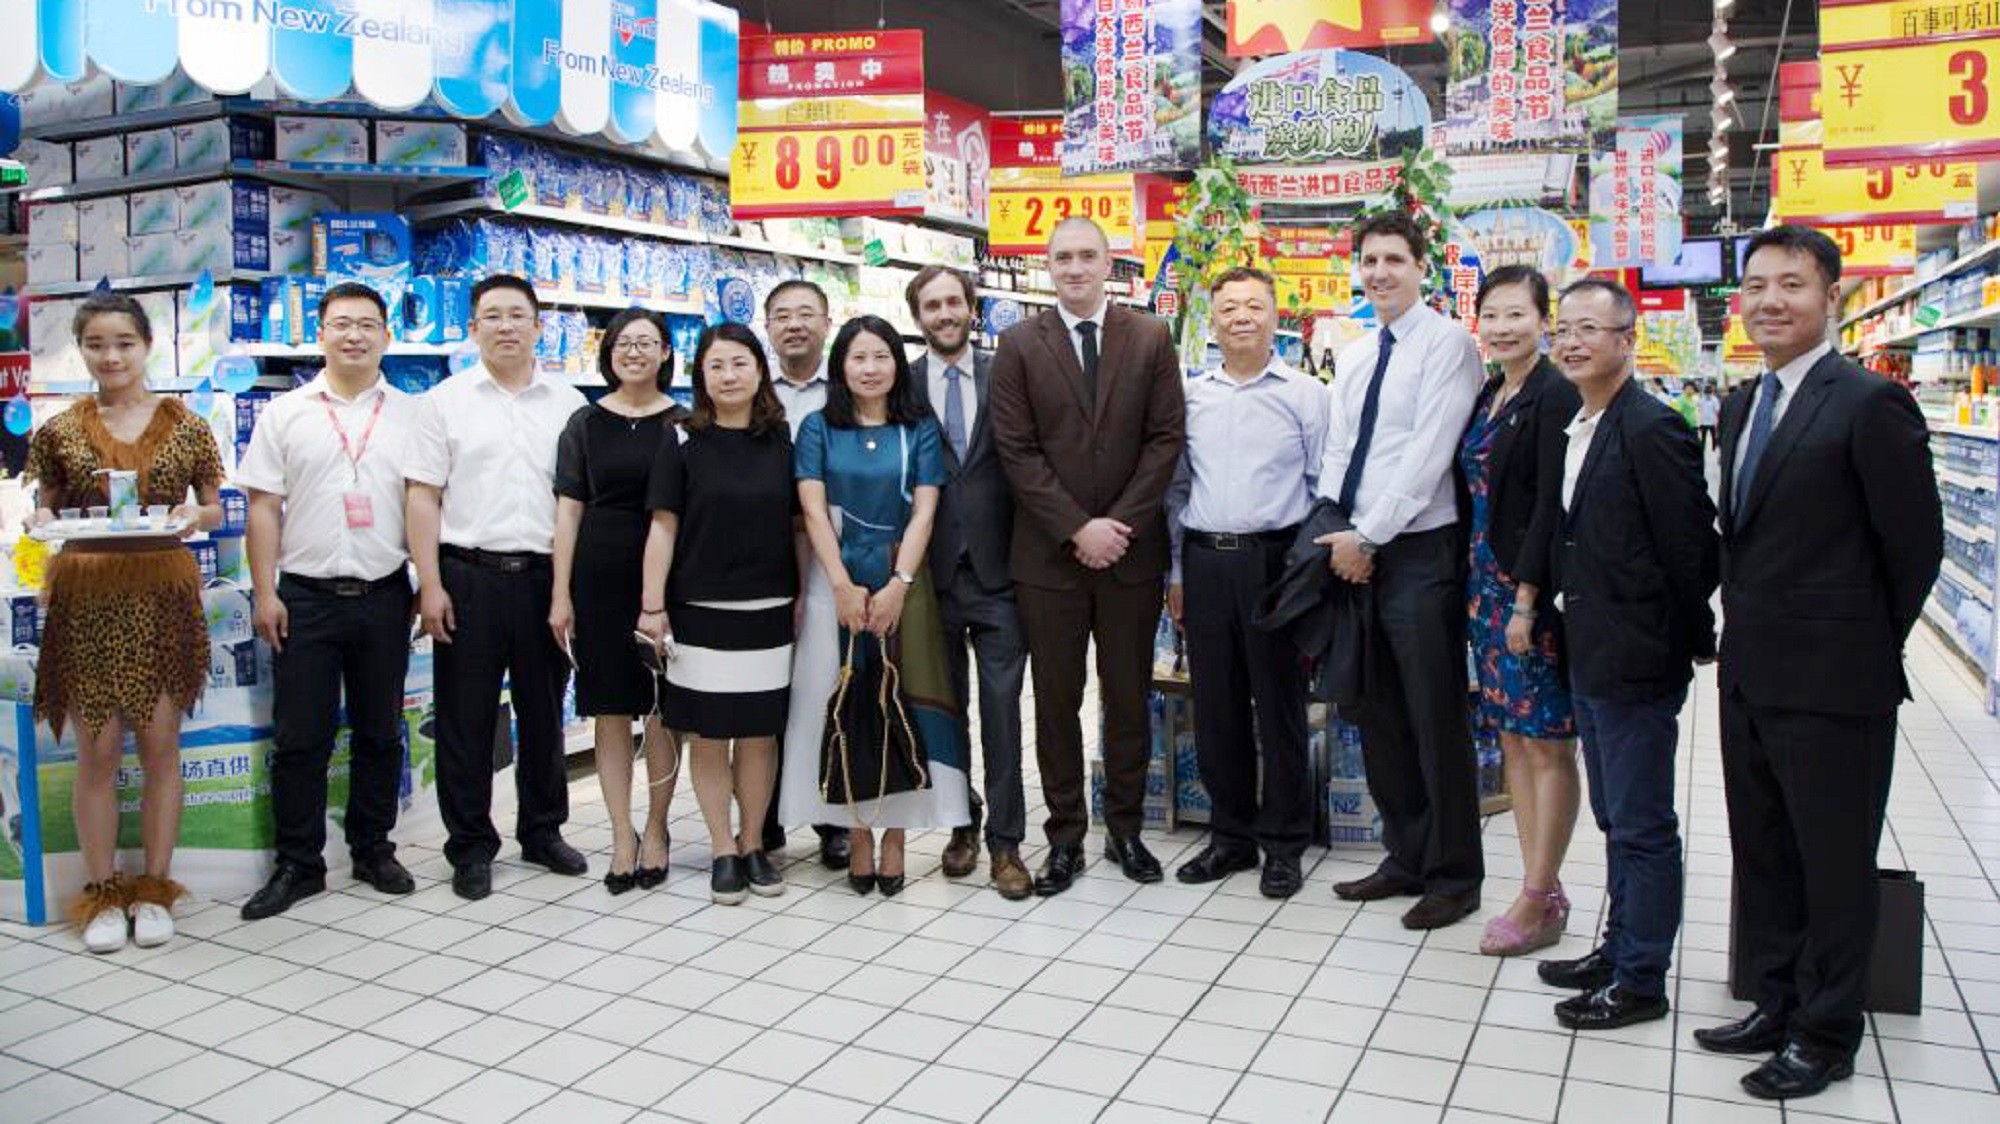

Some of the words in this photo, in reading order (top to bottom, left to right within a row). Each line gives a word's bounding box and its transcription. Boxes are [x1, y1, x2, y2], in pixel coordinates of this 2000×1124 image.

[253, 0, 328, 32] New
[544, 40, 597, 75] From
[601, 54, 643, 84] New
[811, 36, 876, 51] PROMO
[1524, 0, 1551, 119] 兰食品节
[1249, 75, 1385, 119] 进口食品
[1948, 50, 1989, 126] 3
[775, 135, 896, 190] 89.00
[1025, 196, 1112, 236] 2390
